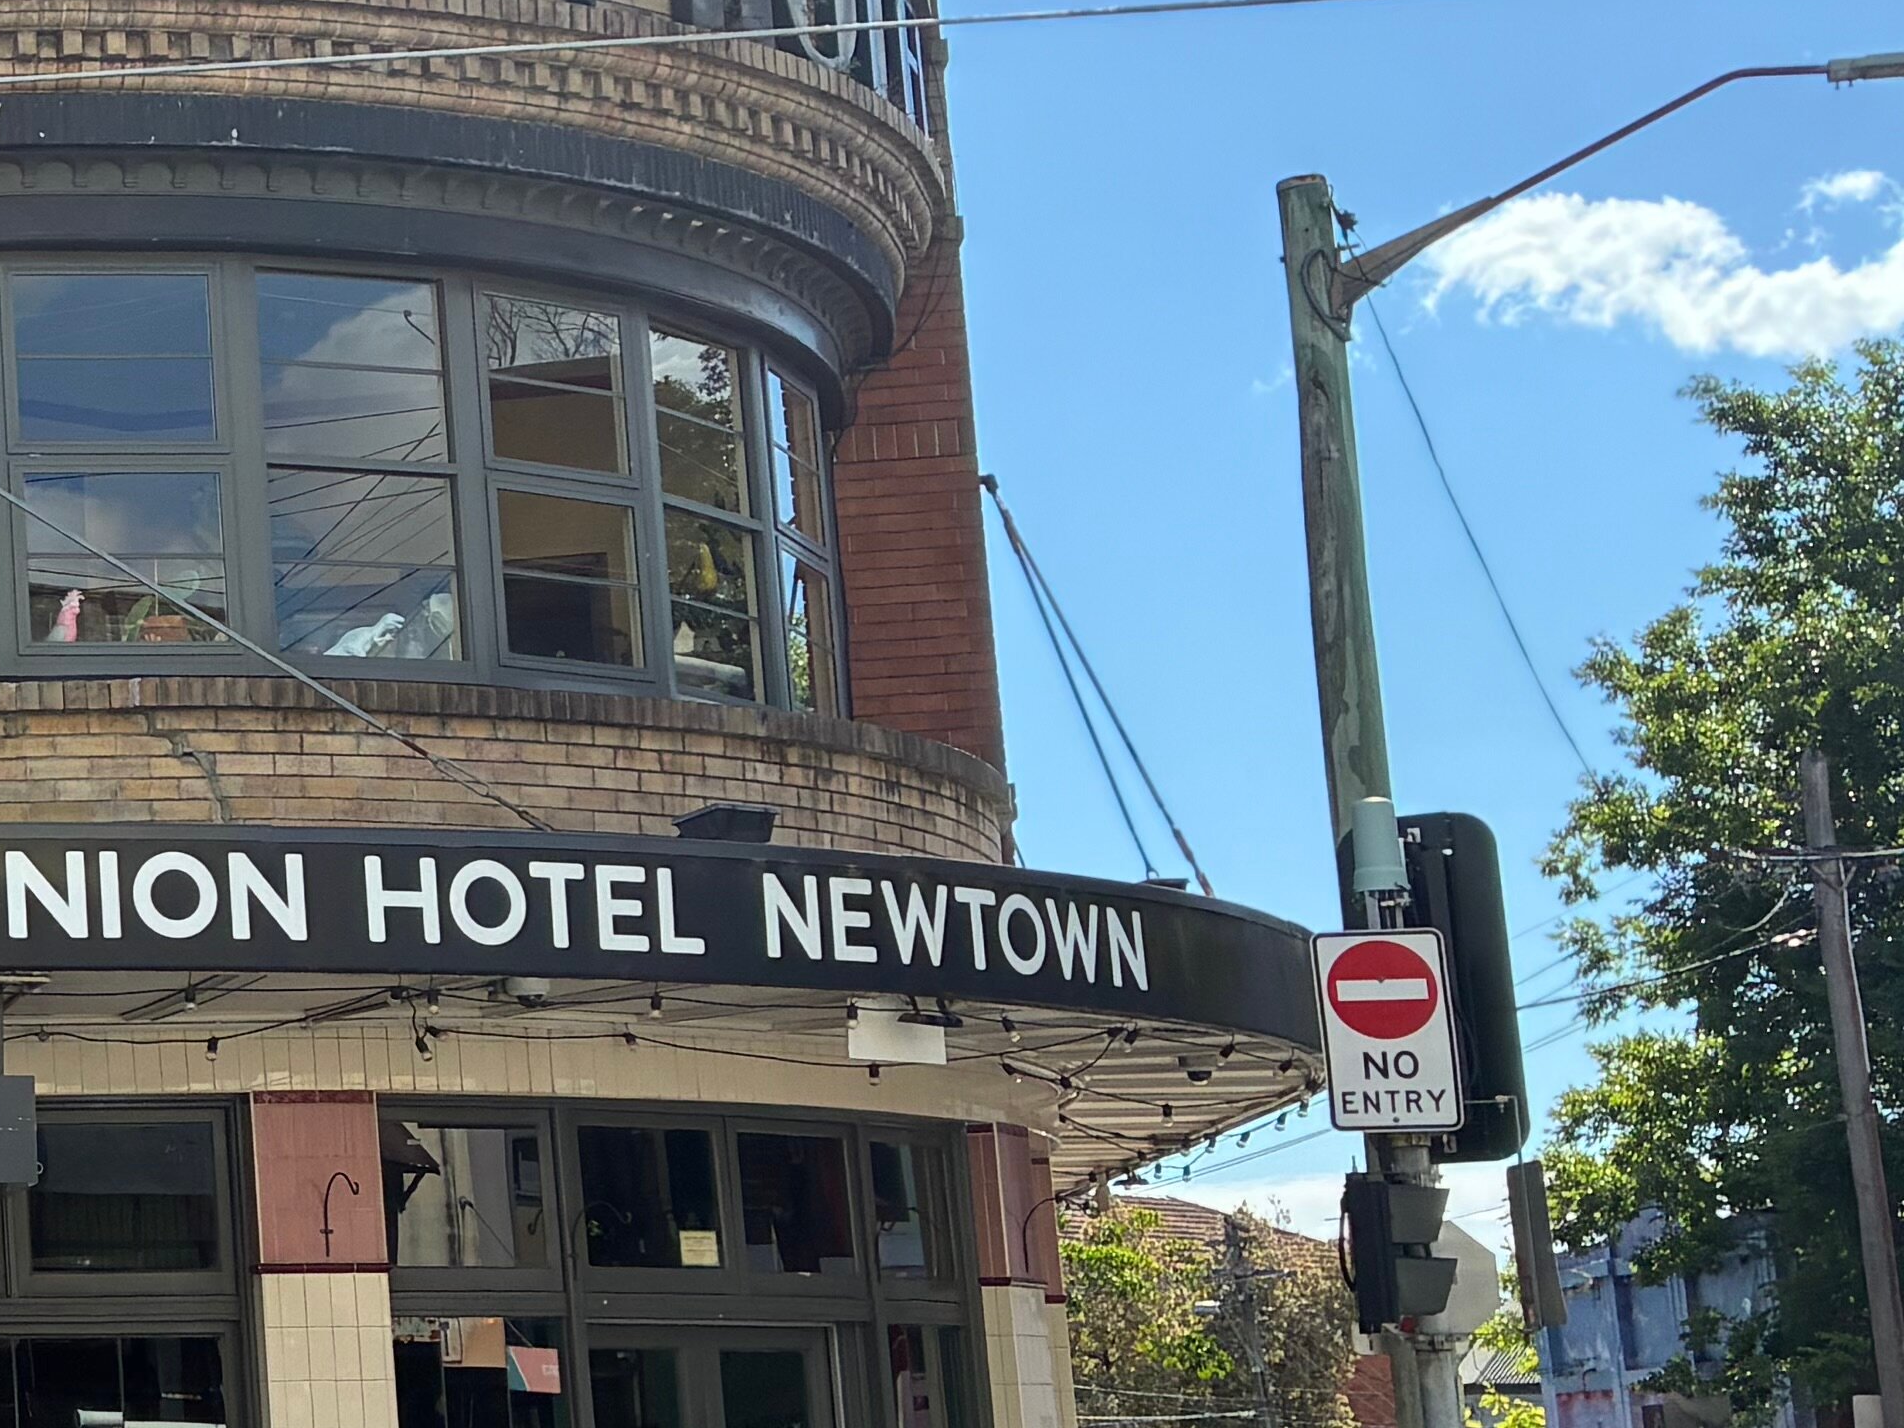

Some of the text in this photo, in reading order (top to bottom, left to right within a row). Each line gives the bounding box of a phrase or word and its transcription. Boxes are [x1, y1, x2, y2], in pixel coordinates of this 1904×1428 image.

[365, 856, 704, 954] HOTEL
[762, 870, 1149, 990] NEWTOWN
[1362, 1050, 1419, 1080] NO
[1341, 1088, 1446, 1114] ENTRY
